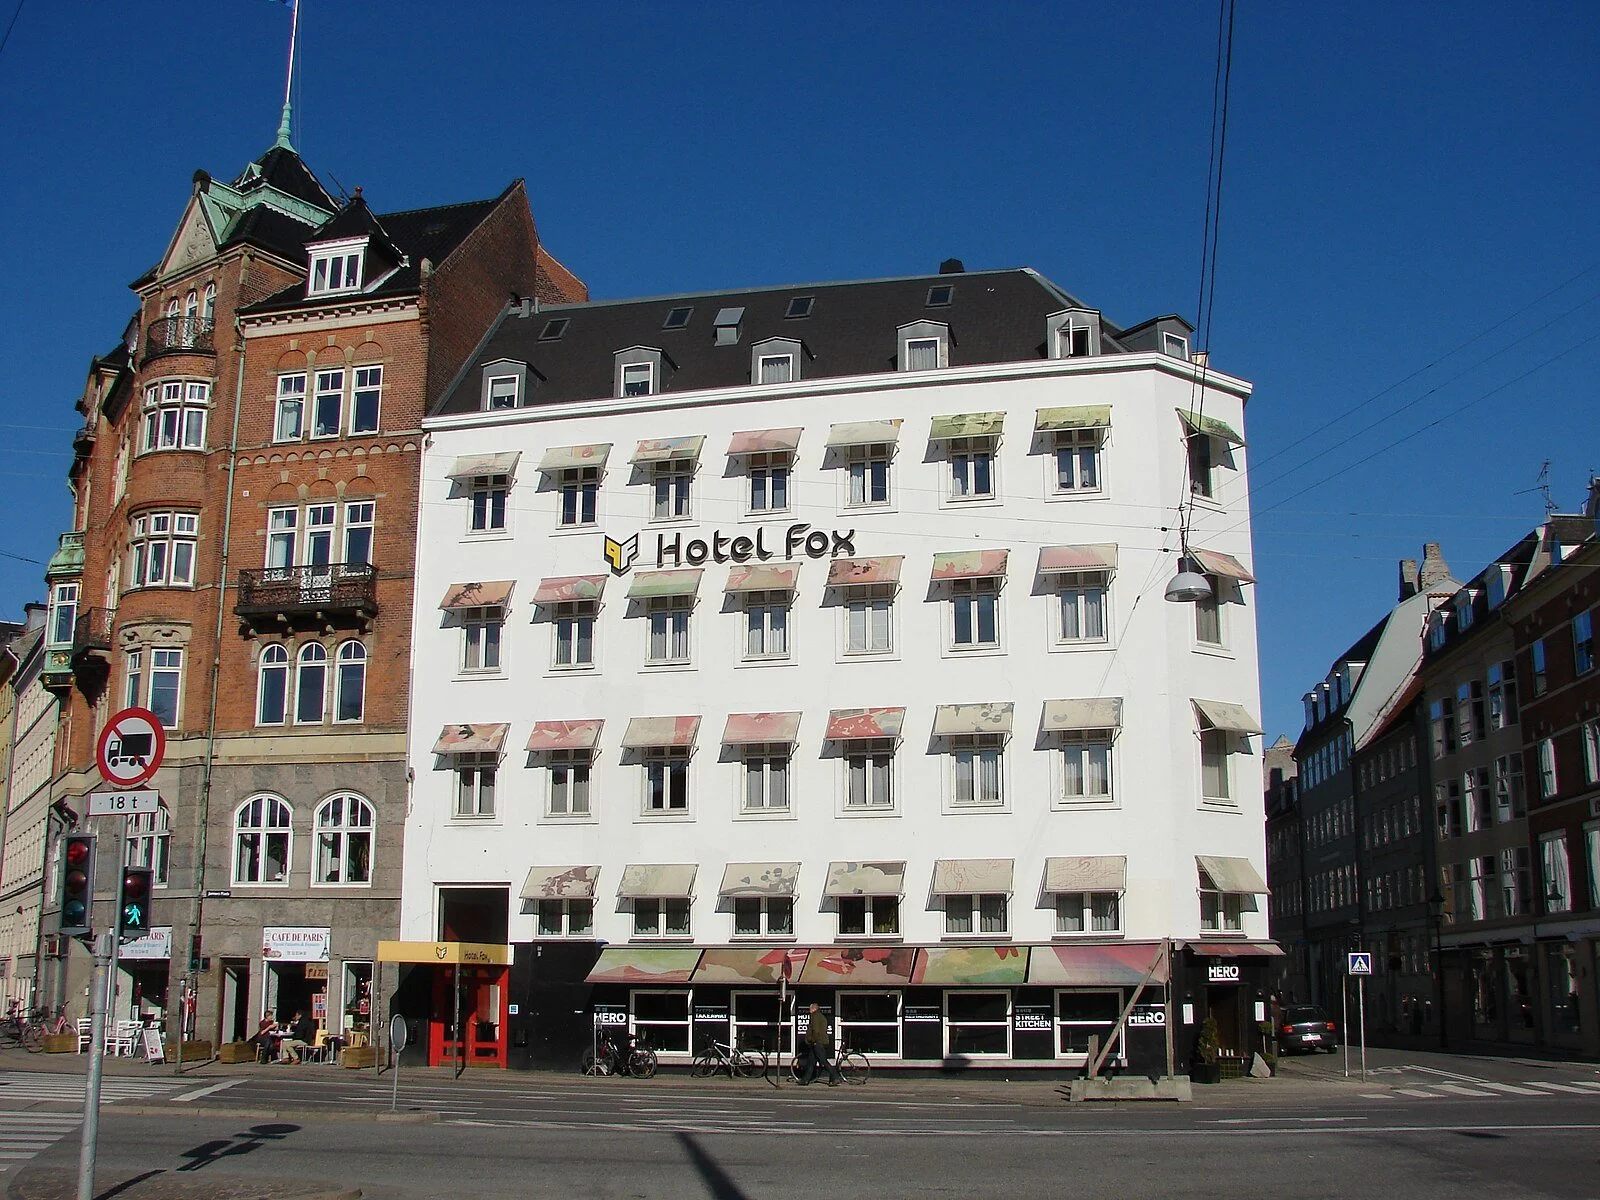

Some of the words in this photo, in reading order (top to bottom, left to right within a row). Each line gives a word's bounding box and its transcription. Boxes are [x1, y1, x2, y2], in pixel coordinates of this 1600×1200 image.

[657, 526, 774, 570] Hotel
[786, 523, 857, 559] Fox
[109, 796, 125, 809] 18
[131, 796, 138, 809] t
[271, 932, 291, 942] CAFE
[292, 932, 302, 942] DE
[303, 932, 324, 942] PARIS
[1208, 966, 1239, 978] HERO
[594, 1012, 627, 1023] HERO
[1015, 1013, 1046, 1021] STREET
[1128, 1011, 1166, 1023] HERO
[1015, 1020, 1052, 1028] KITCHEN
